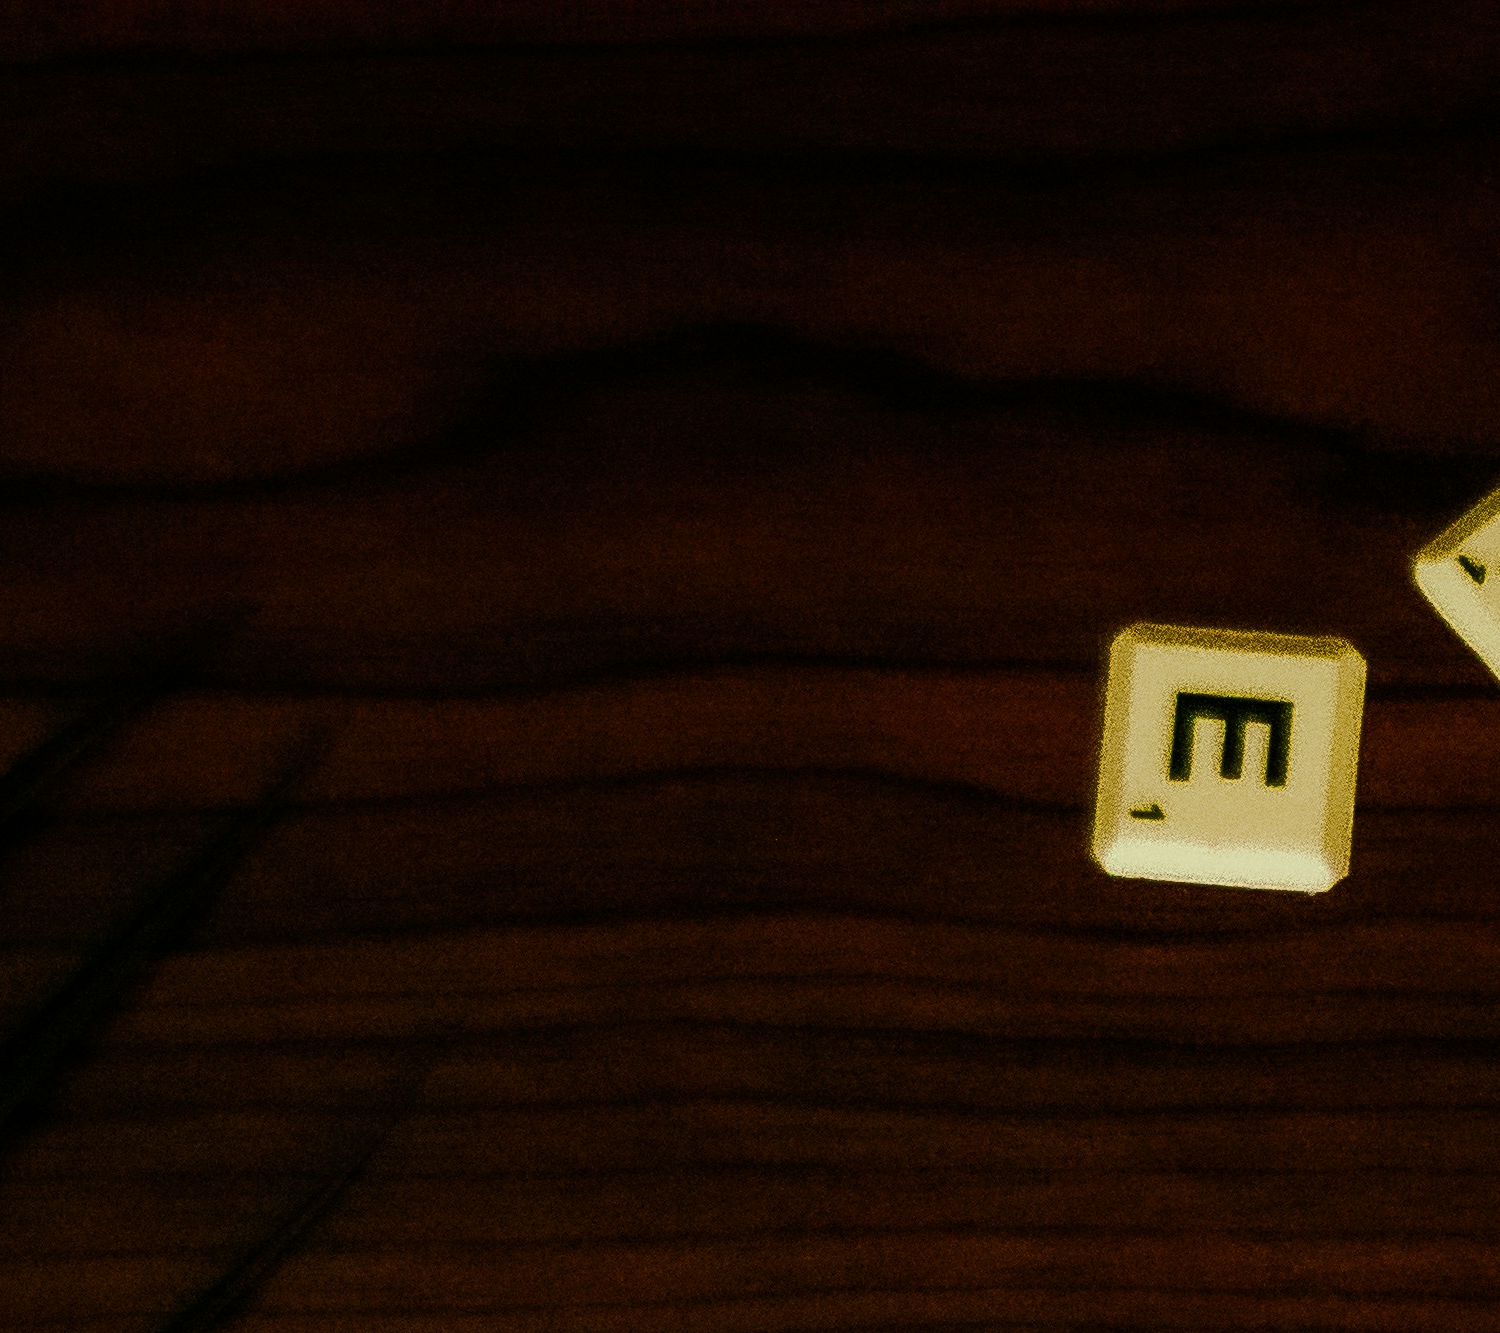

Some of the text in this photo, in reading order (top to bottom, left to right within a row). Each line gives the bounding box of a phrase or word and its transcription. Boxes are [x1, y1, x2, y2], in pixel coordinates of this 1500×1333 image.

[1458, 555, 1486, 584] 1
[1167, 690, 1294, 788] E
[1130, 804, 1164, 820] 1
